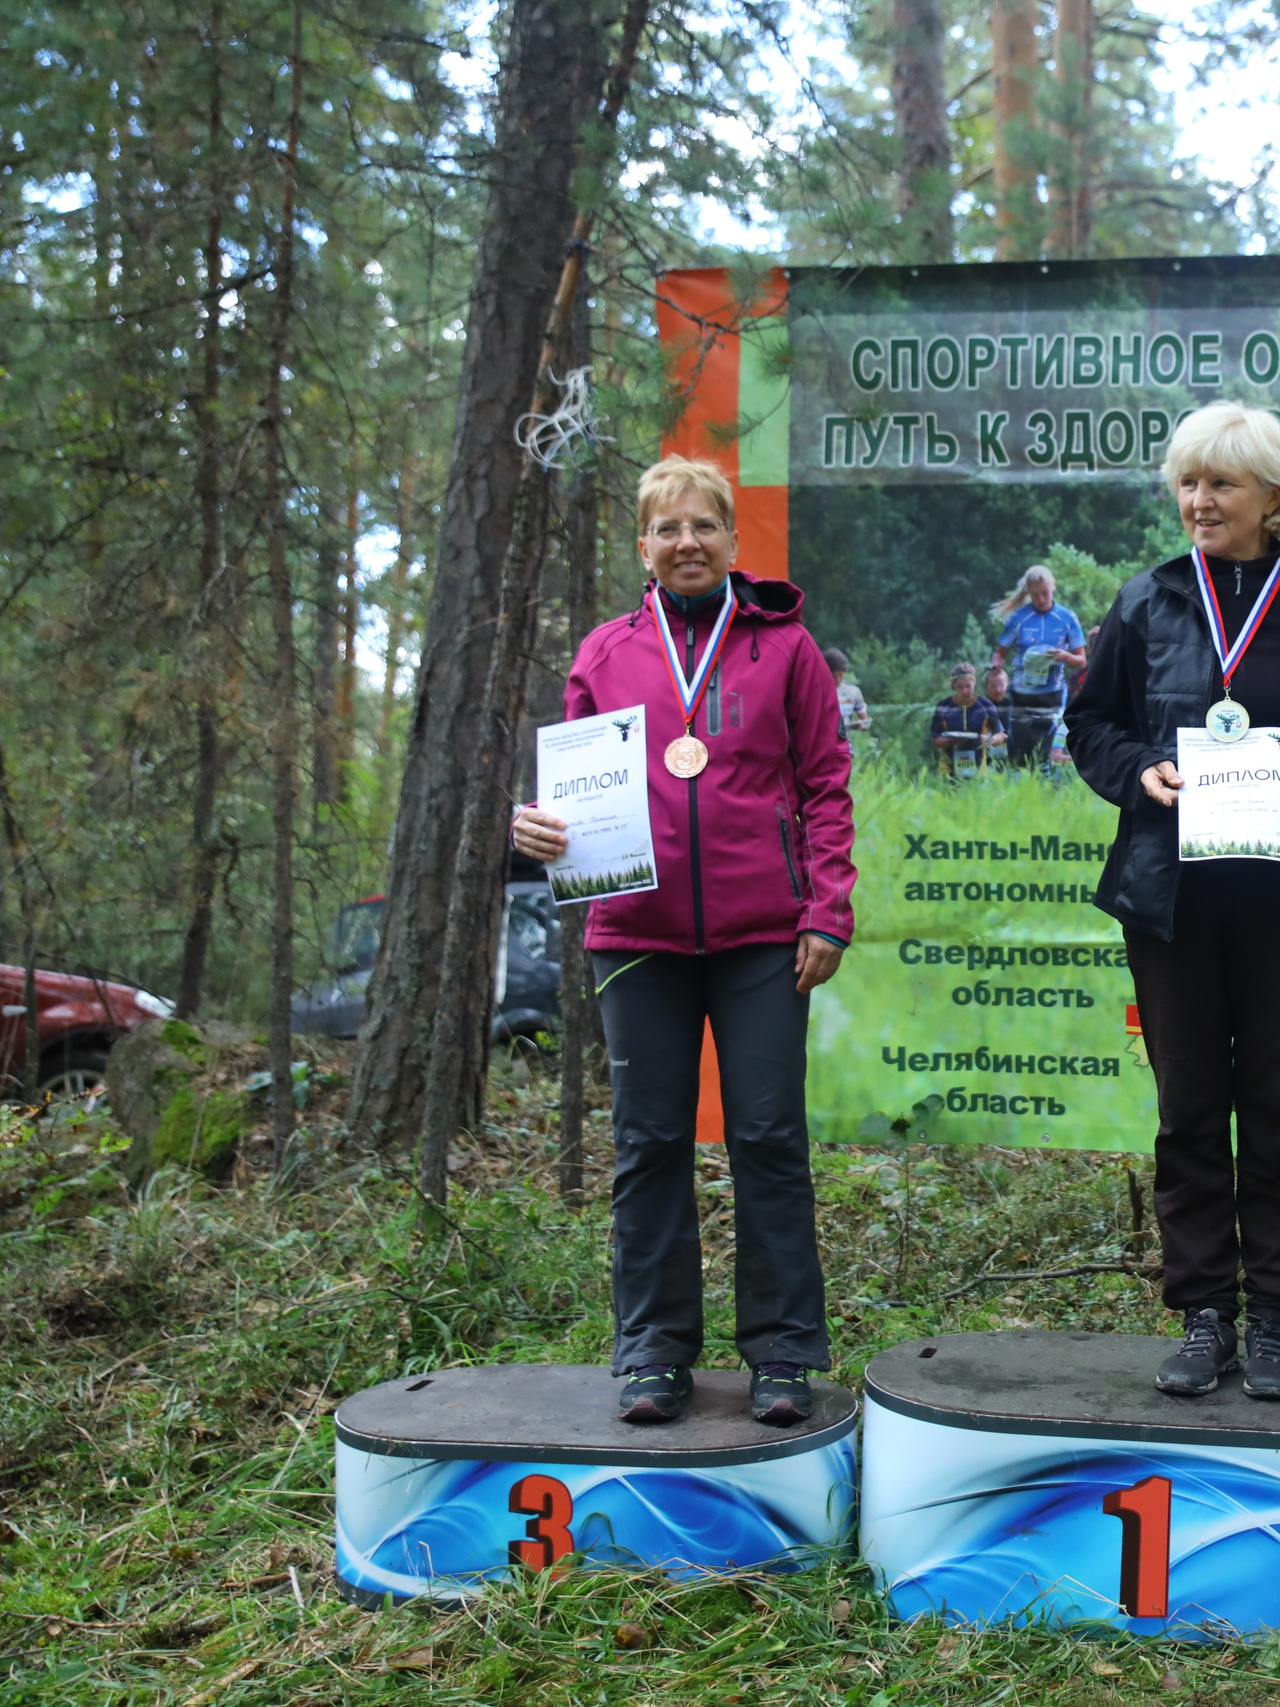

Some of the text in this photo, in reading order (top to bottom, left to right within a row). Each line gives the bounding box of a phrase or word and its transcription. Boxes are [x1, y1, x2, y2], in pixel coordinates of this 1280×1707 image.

[852, 332, 1221, 390] СПОРТИВНОЕ
[824, 412, 957, 466] ПУТЬ
[980, 411, 1009, 466] К
[553, 769, 628, 800] ДИПЛОМ
[899, 939, 1128, 970] Свердловска
[952, 980, 1095, 1007] область
[882, 1046, 1120, 1076] Челябинская
[509, 1473, 574, 1582] 3
[1103, 1475, 1172, 1618] 1
